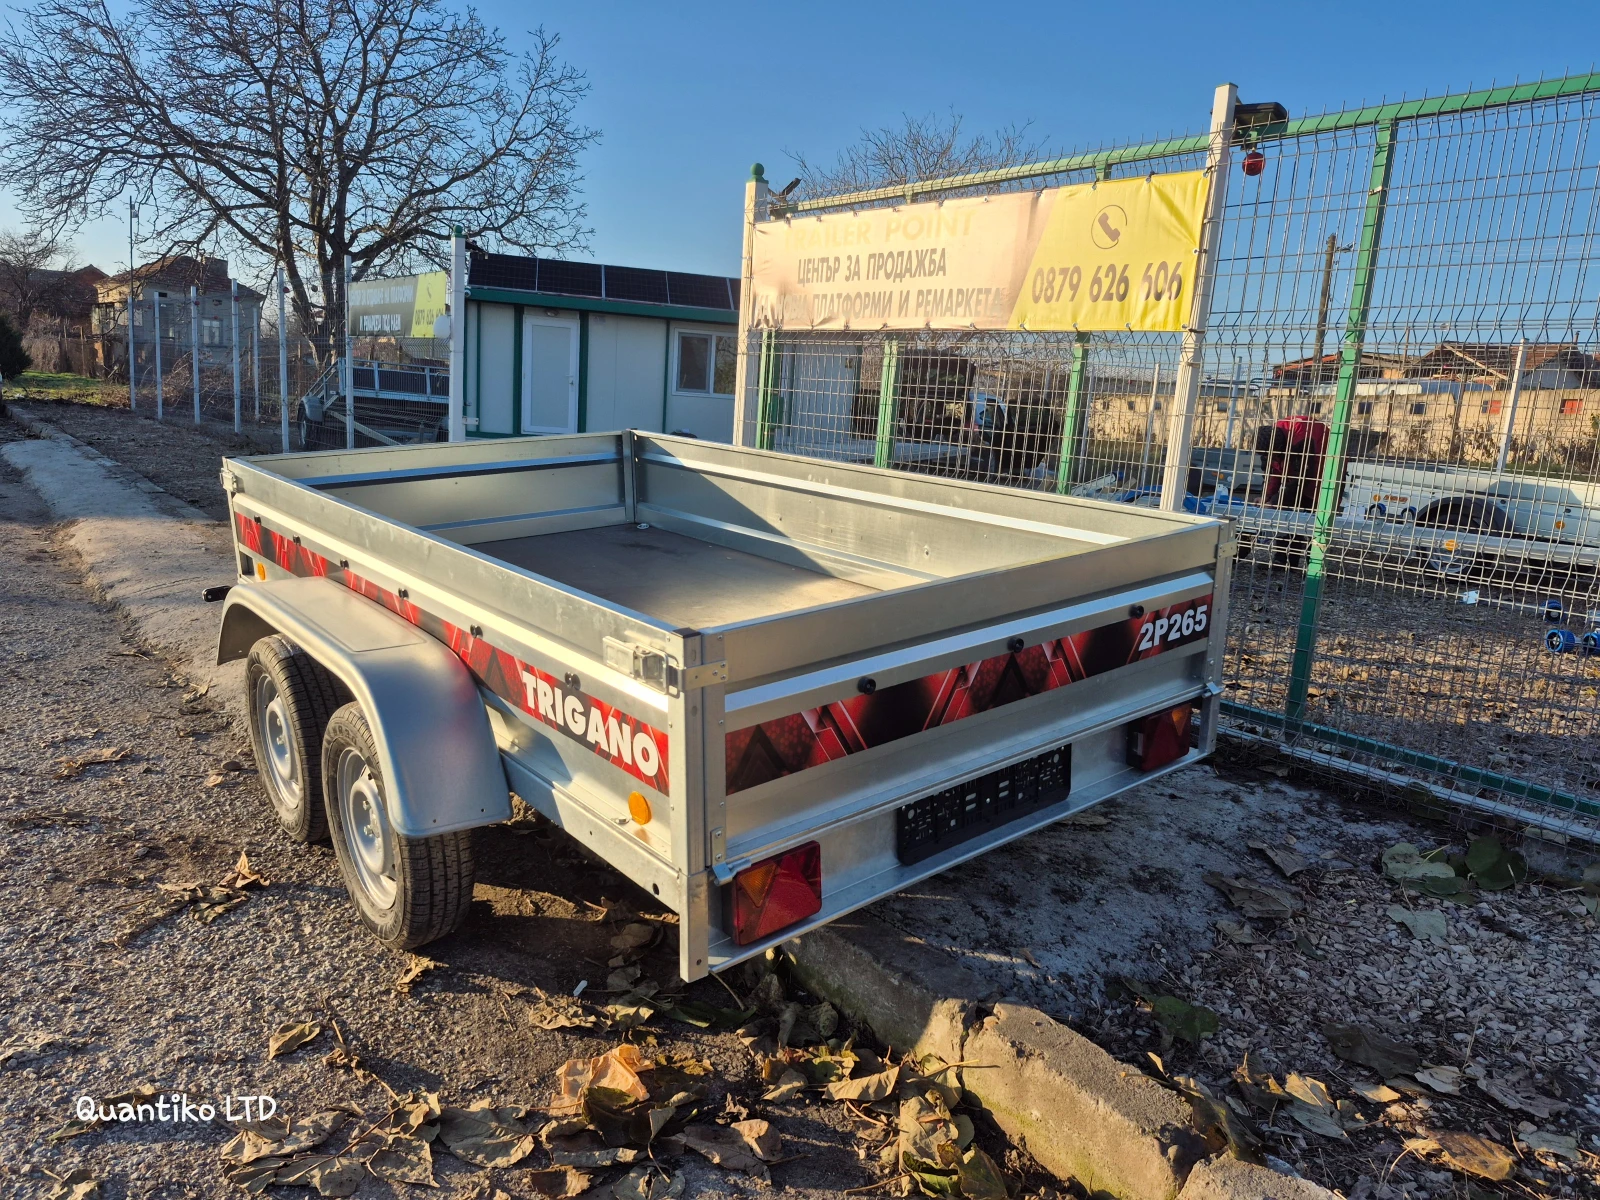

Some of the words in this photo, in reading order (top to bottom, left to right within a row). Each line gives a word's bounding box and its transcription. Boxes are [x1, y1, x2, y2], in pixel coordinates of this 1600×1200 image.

[783, 219, 872, 251] TRAILER
[884, 208, 978, 242] POINT
[797, 256, 841, 287] ЦЕНТЪР
[844, 254, 861, 282] ЗА
[866, 248, 947, 284] ПРОДАЖБА
[1031, 265, 1082, 304] 0879
[1089, 263, 1130, 303] 626
[1140, 260, 1183, 302] 606
[812, 290, 893, 320] ПЛАТФОРМИ
[898, 289, 911, 318] И
[915, 287, 1002, 318] РЕМАРКЕТА
[1138, 605, 1208, 651] 2P265
[522, 670, 659, 777] TRIGANO
